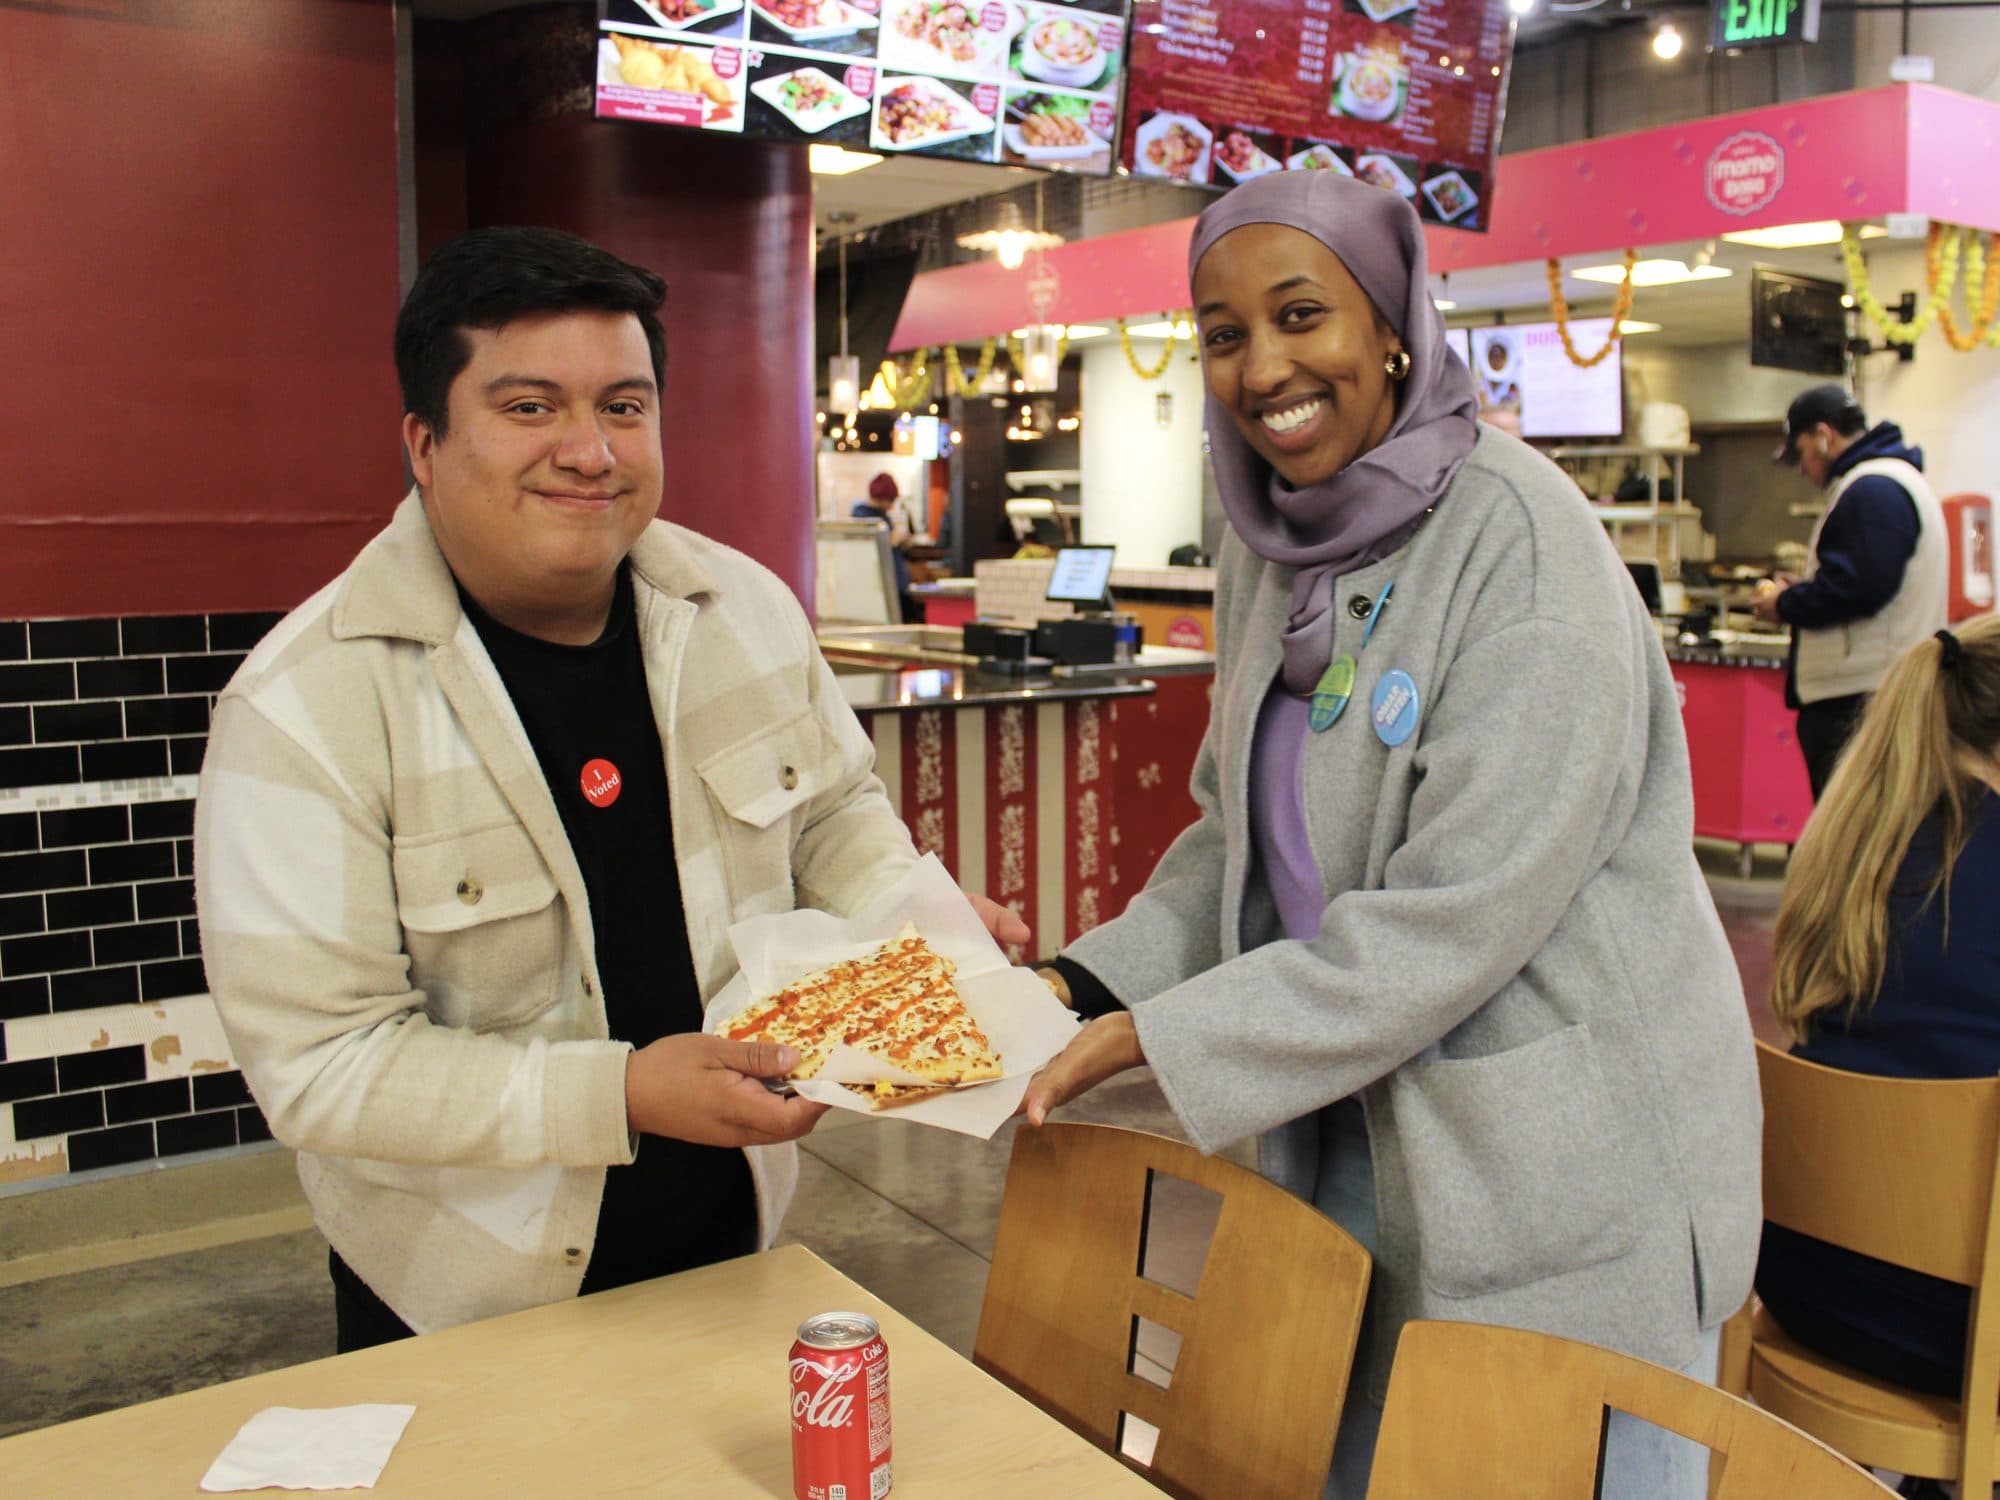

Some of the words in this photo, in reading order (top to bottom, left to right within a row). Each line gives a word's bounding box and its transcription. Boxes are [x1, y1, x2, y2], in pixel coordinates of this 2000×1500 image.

[1725, 0, 1787, 41] EXIT
[589, 772, 619, 798] Voted
[593, 769, 602, 781] I
[863, 1343, 885, 1361] Coke
